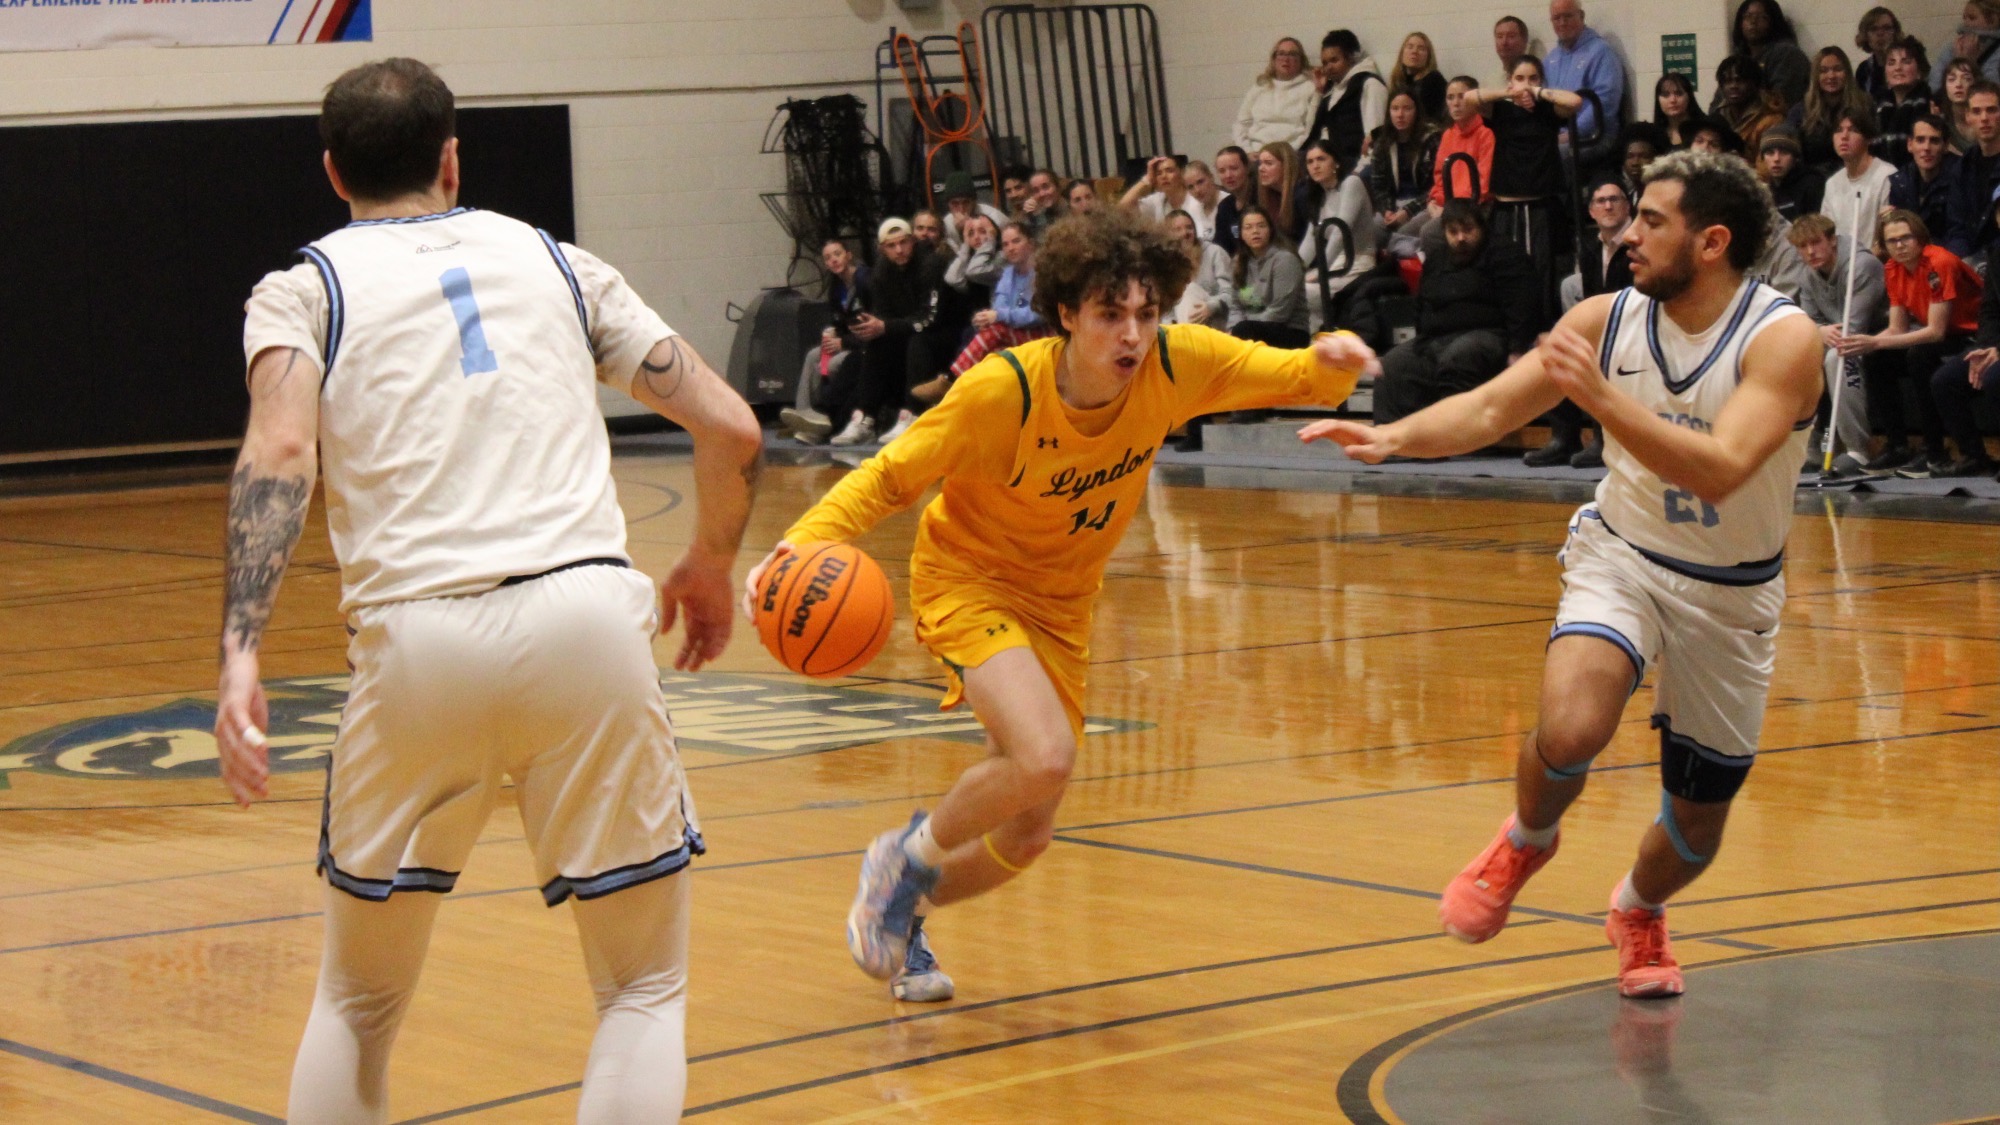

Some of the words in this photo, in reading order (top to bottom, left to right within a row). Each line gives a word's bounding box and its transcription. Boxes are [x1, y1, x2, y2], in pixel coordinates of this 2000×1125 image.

[438, 266, 498, 379] 1
[1039, 446, 1154, 502] Lyndon
[1068, 499, 1117, 535] 14
[787, 557, 848, 637] Wilson
